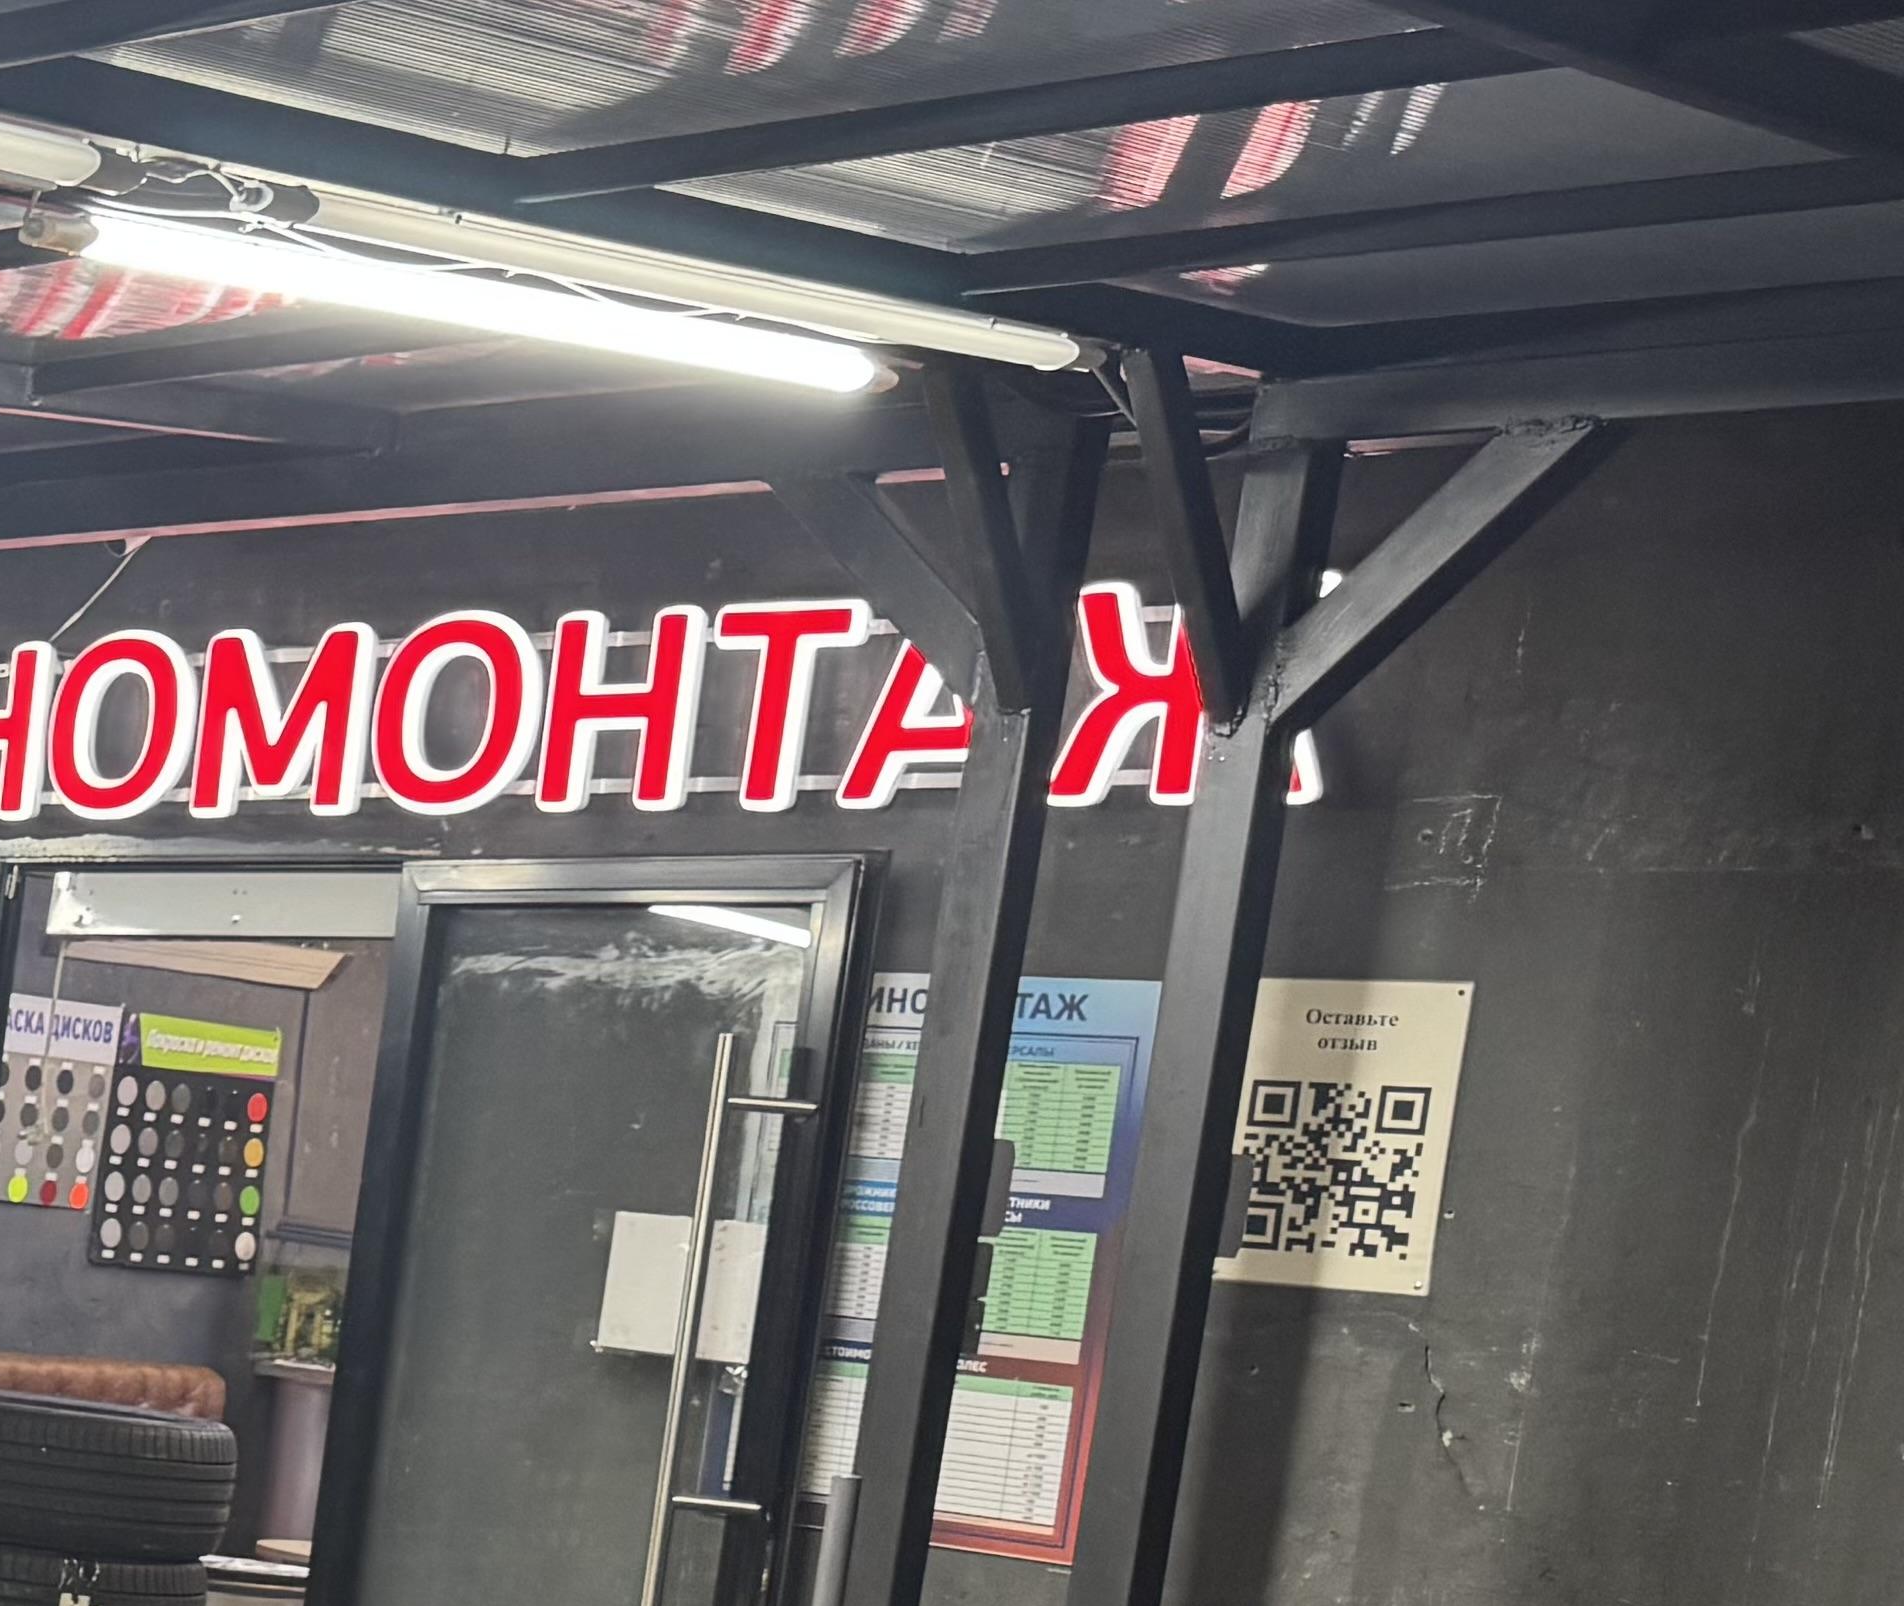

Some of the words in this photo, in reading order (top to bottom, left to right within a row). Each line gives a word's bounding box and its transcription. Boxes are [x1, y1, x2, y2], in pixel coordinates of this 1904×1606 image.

[1305, 1008, 1400, 1027] Оставьте
[51, 1013, 114, 1044] ДИСКОВ
[1317, 1037, 1378, 1051] отзыв
